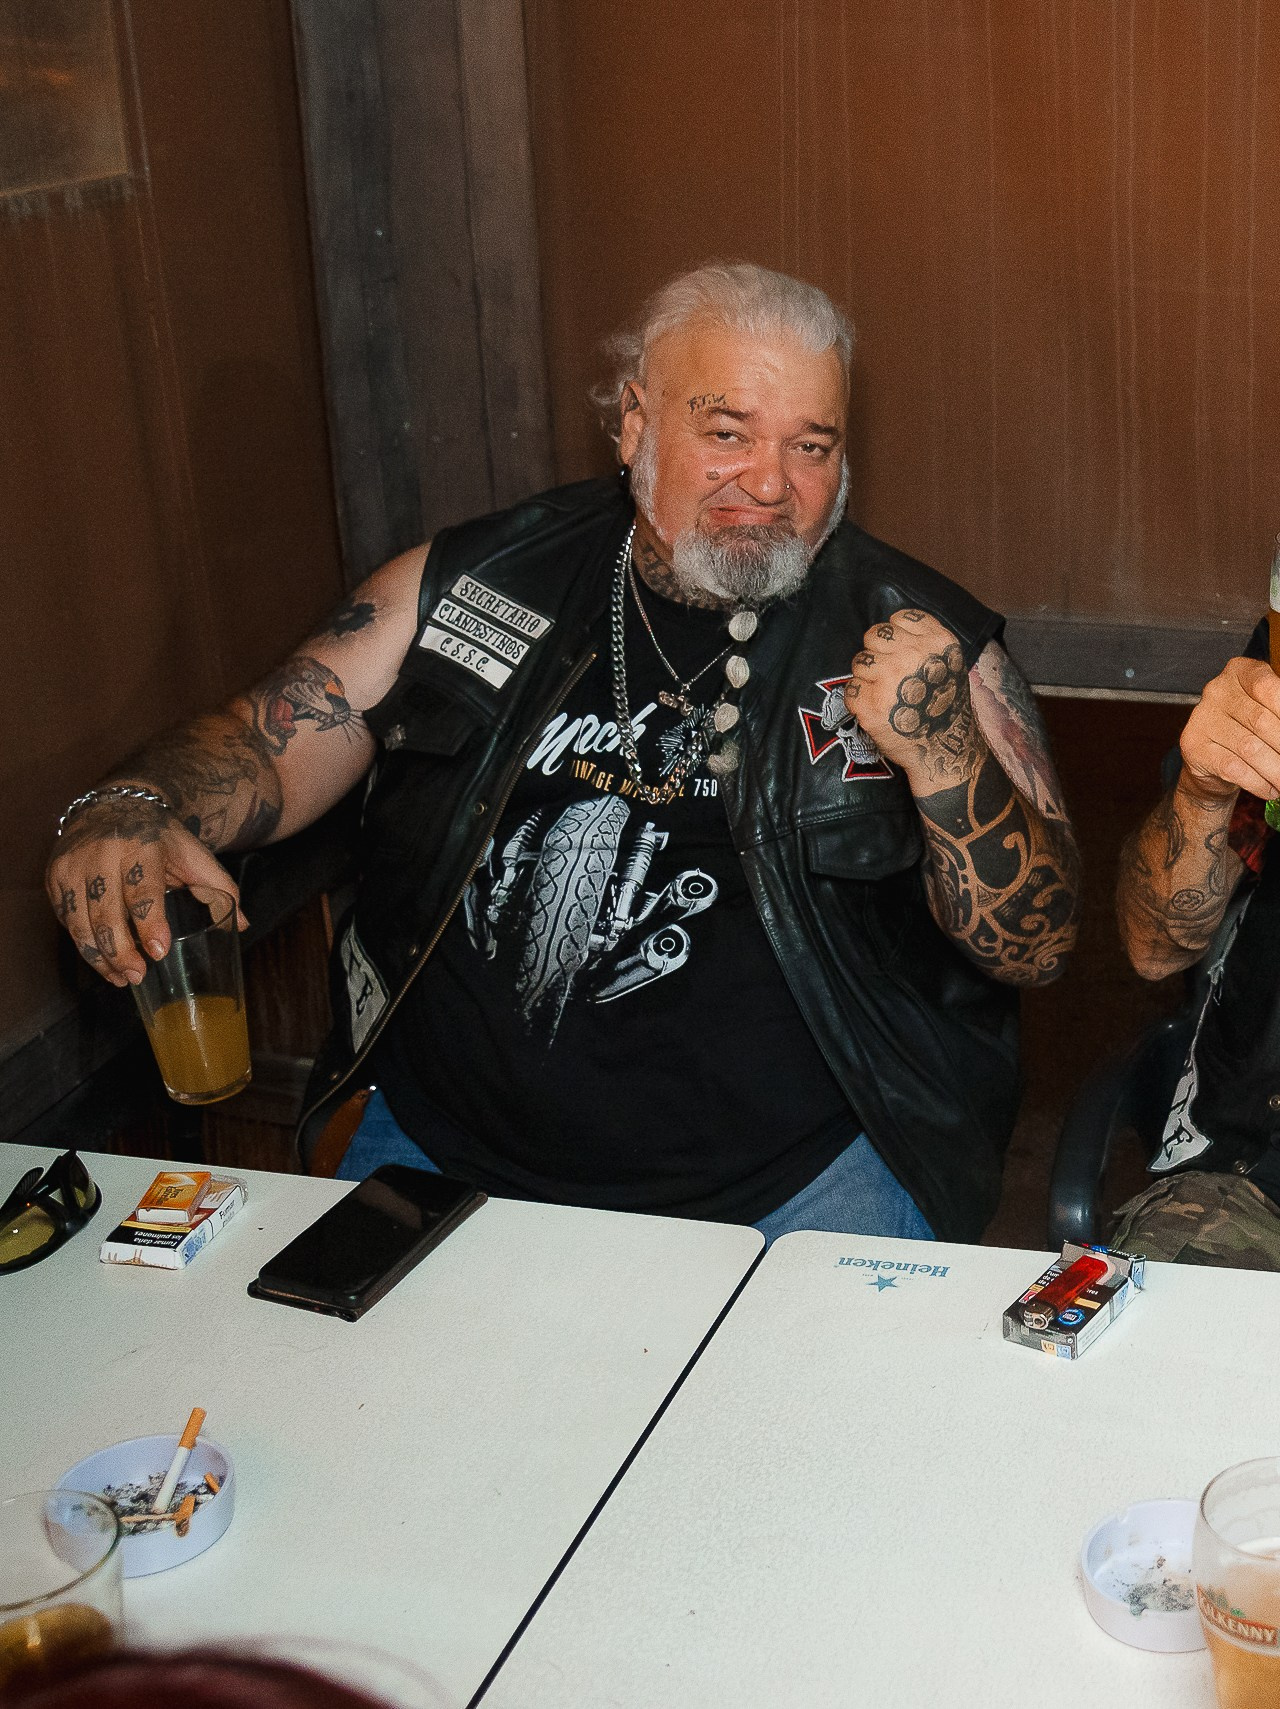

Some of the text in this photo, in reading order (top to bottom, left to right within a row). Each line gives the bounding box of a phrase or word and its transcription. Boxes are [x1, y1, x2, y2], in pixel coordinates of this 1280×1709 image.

[459, 581, 541, 634] SECRETARIO
[438, 603, 526, 660] CLANDESTINOS
[693, 778, 718, 797] 750
[134, 1231, 173, 1240] pulmones
[838, 1257, 951, 1278] Heineken
